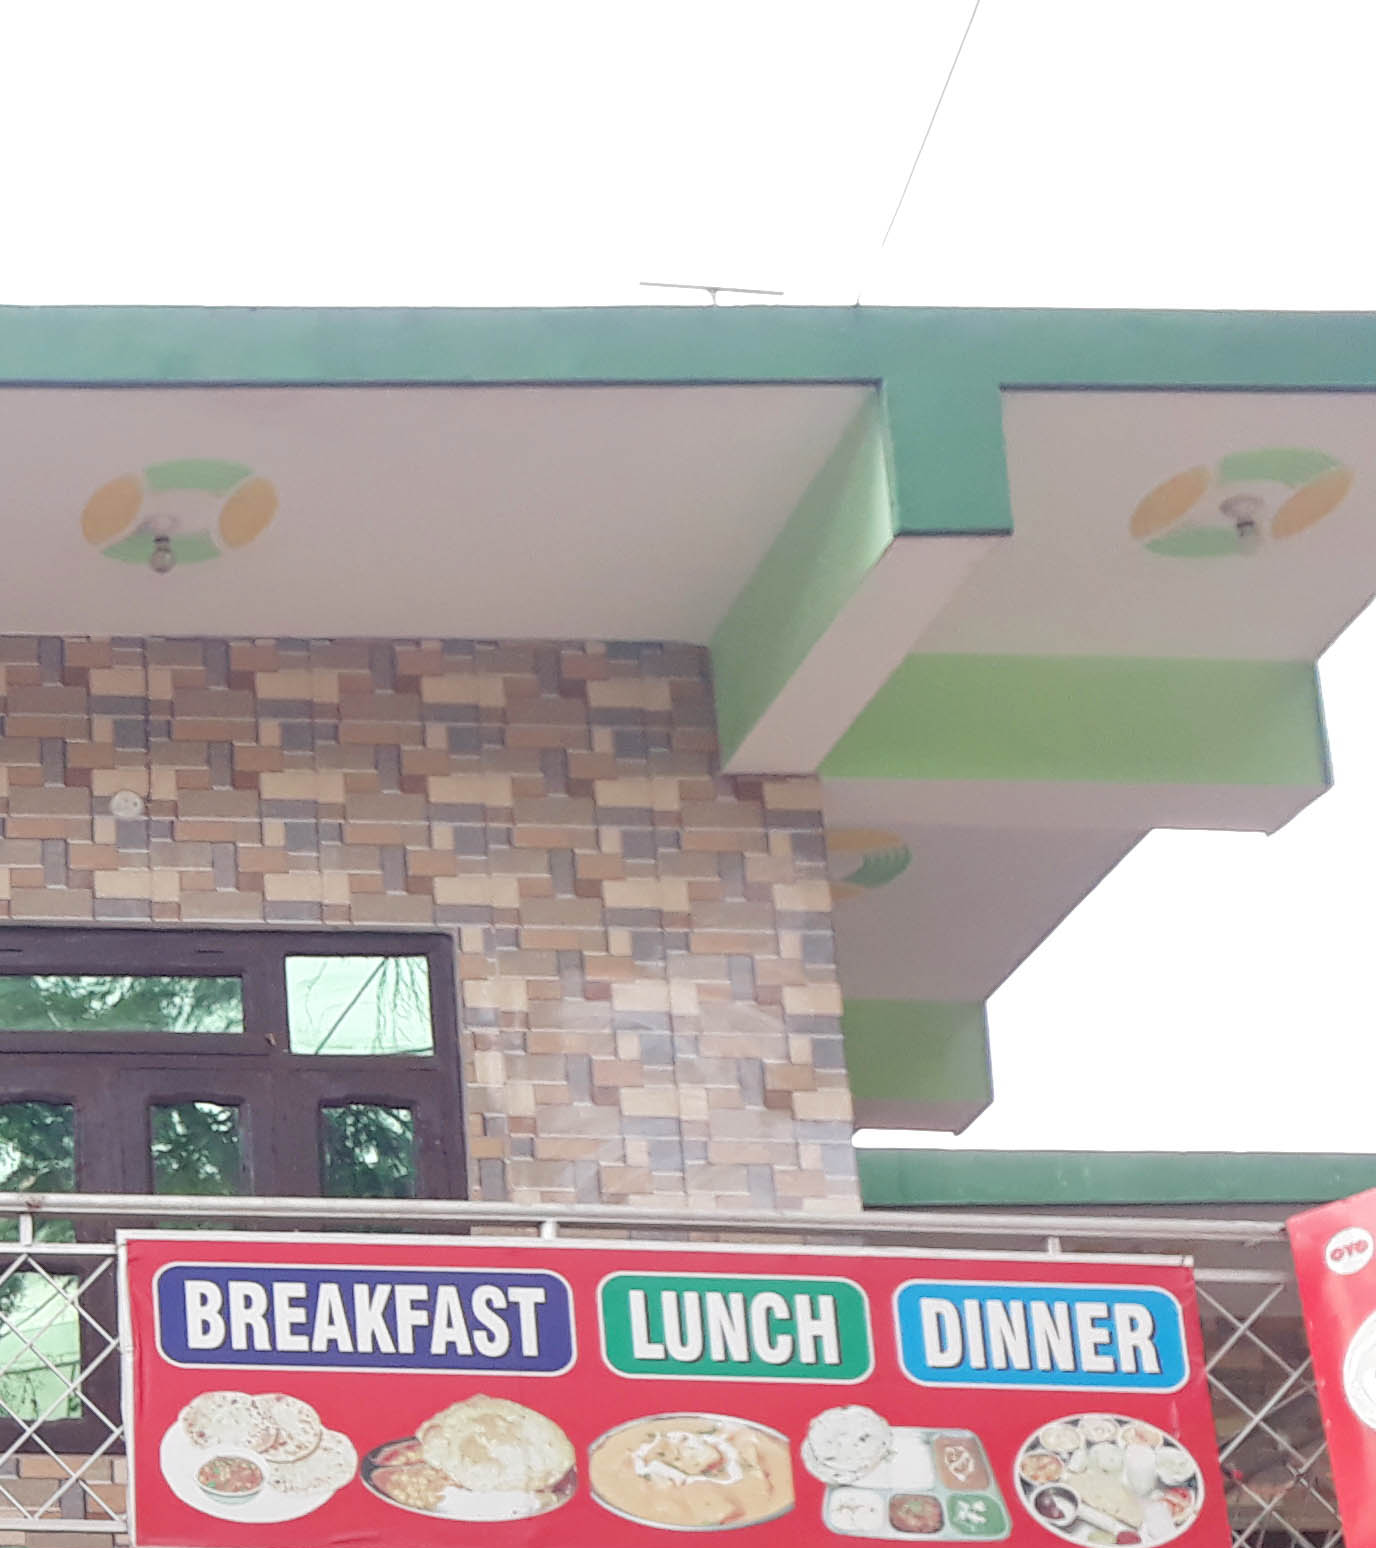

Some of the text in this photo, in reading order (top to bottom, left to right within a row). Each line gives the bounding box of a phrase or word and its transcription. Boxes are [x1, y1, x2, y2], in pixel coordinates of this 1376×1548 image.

[183, 1280, 1162, 1375] BREAKFAST LUNCH DINNER
